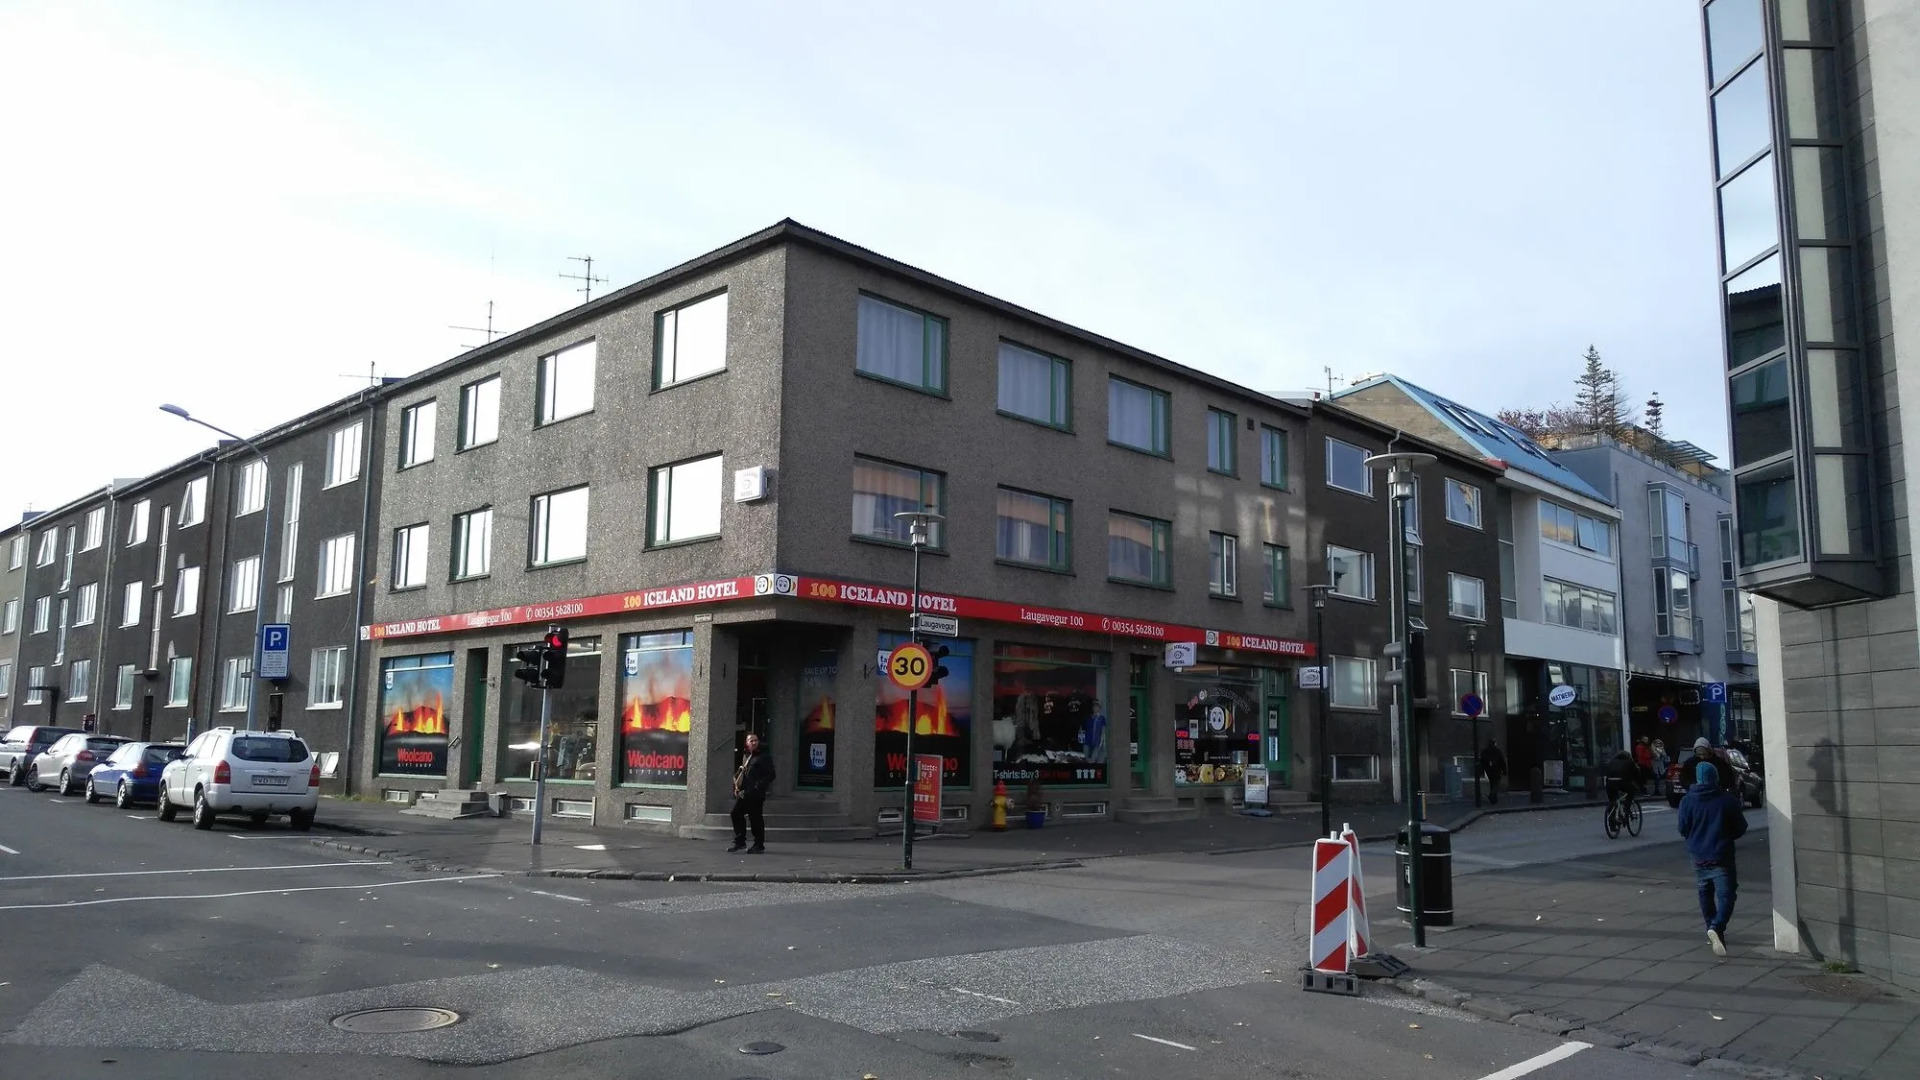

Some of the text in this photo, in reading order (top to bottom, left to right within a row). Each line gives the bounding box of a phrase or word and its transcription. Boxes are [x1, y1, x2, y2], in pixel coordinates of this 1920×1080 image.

[623, 581, 739, 608] 100 ICELAND HOTEL
[810, 583, 837, 597] 100
[840, 585, 907, 606] ICELAND
[500, 611, 512, 623] 100
[534, 603, 583, 618] 00354 5628100
[1020, 608, 1084, 626] Laugavegur 100
[374, 618, 440, 638] 100 ICELAND HOTEL
[920, 618, 955, 631] Laugavegur
[1112, 620, 1164, 636] 00354 5628100
[270, 631, 282, 647] P
[1226, 635, 1305, 654] 100 ICELAND HOTEL
[879, 654, 888, 663] ta
[894, 657, 925, 676] 30
[1550, 691, 1574, 702] MATWERK
[1712, 687, 1722, 699] P
[397, 747, 433, 763] Woolcano
[628, 750, 685, 769] Woolcano
[812, 747, 823, 756] tax
[812, 756, 825, 765] free
[1021, 769, 1034, 780] Buy
[1034, 769, 1039, 779] 3
